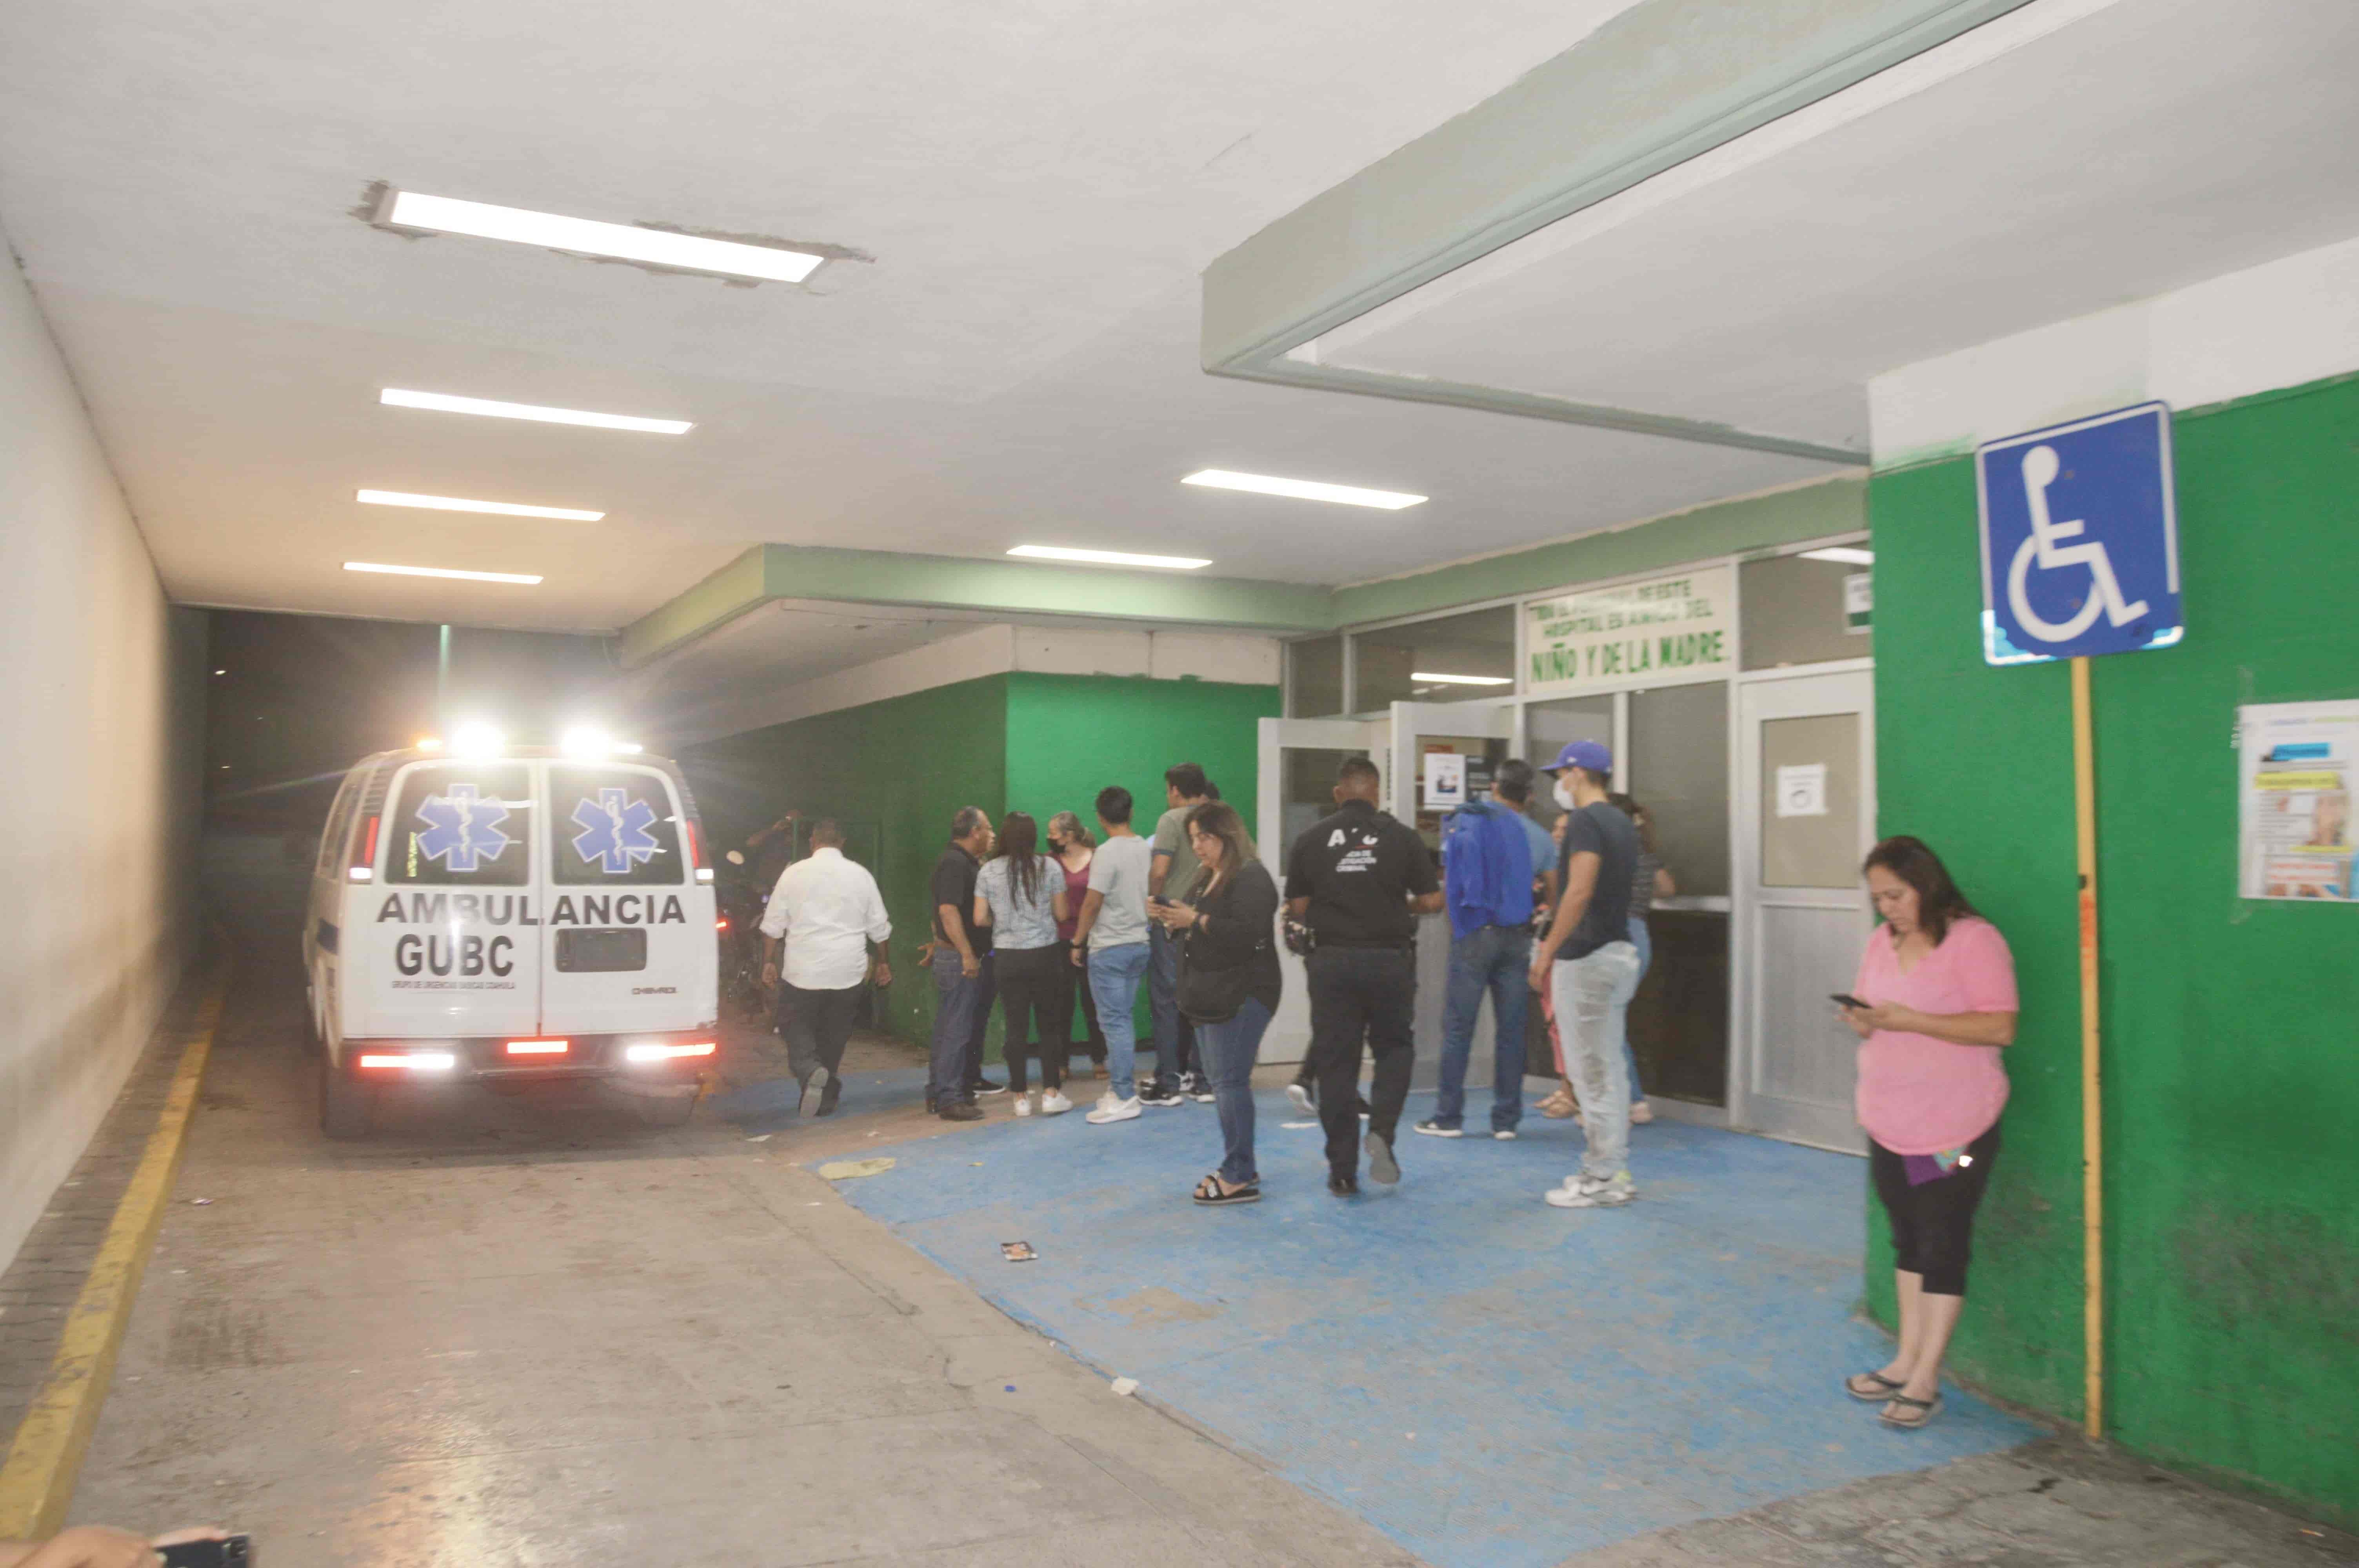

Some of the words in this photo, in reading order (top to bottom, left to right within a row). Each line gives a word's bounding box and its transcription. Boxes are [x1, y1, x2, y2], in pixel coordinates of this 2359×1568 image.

[1531, 642, 1577, 682] NIÑO
[1586, 645, 1598, 677] Y
[1602, 642, 1623, 675] DE
[1627, 638, 1651, 673] LA
[1659, 630, 1724, 669] MADRE
[376, 892, 686, 926] AMBULANCIA
[396, 933, 514, 977] GUBC
